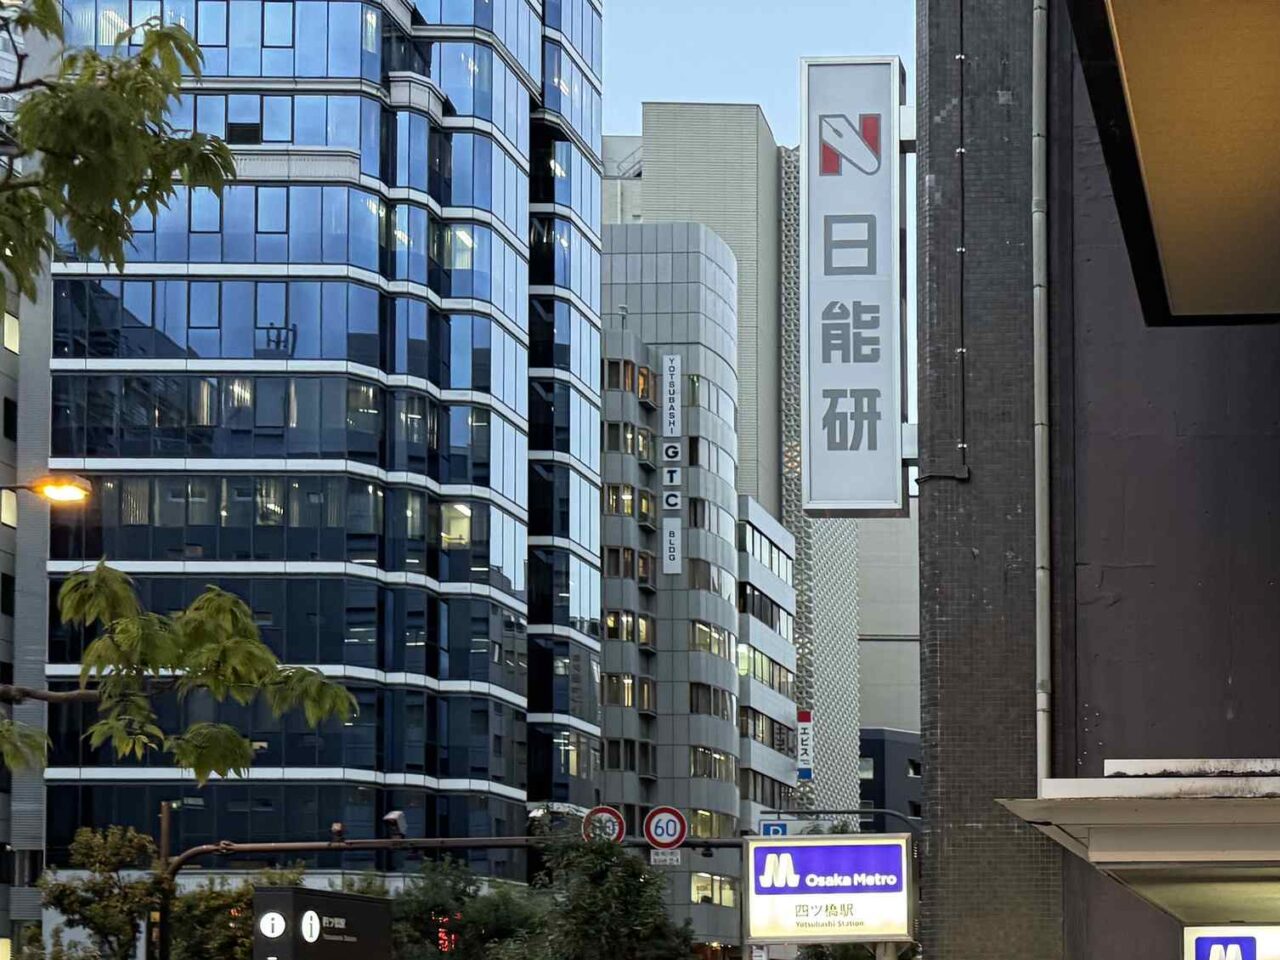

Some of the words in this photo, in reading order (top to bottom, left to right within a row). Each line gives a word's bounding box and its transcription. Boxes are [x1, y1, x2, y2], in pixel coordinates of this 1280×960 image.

[822, 214, 882, 451] 日能研
[668, 357, 676, 435] YOTSUBASHI
[664, 444, 680, 508] GTC
[668, 530, 676, 562] BLDG
[654, 818, 677, 837] 60
[805, 872, 852, 887] Osaka
[853, 872, 898, 887] Metro
[795, 903, 854, 918] 四ツ橋駅
[837, 919, 865, 928] Station
